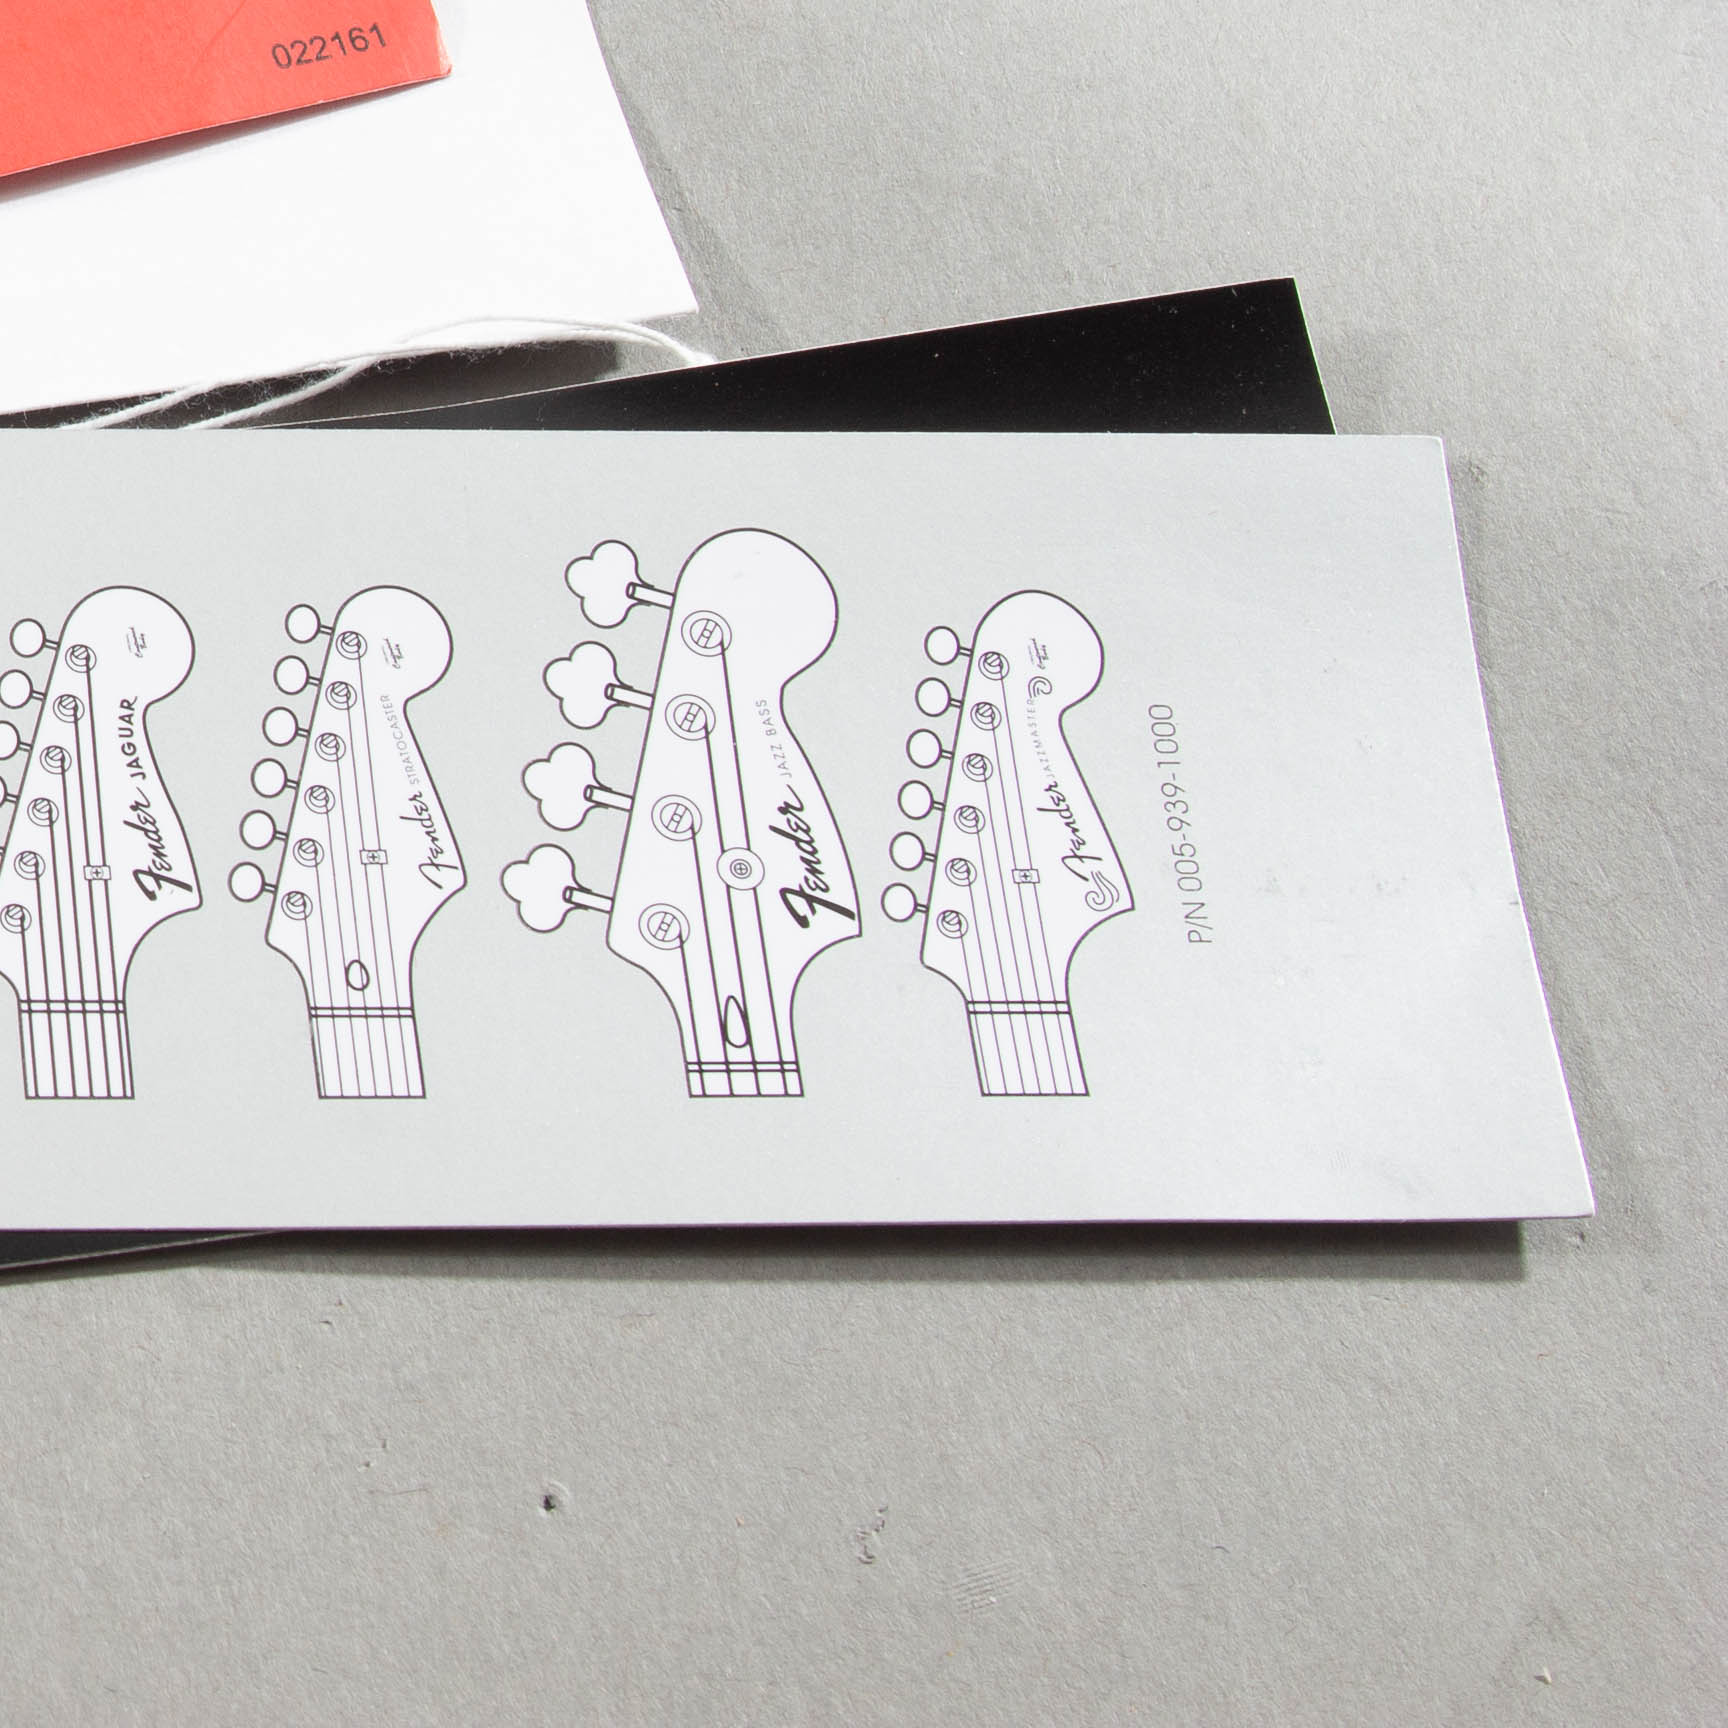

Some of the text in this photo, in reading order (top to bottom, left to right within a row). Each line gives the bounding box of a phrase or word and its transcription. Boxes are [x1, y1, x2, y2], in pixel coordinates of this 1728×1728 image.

[271, 23, 387, 70] 022161
[118, 696, 146, 780] JAGUAR
[380, 695, 420, 785] STRATOCASTER
[1027, 699, 1055, 778] JAZZMASTER
[123, 786, 193, 901] Fender
[399, 791, 458, 889] Fender
[756, 699, 855, 929] Fender JAZZ BASS
[1036, 781, 1102, 881] Fender
[1148, 704, 1213, 943] P/N 005-939-1000
